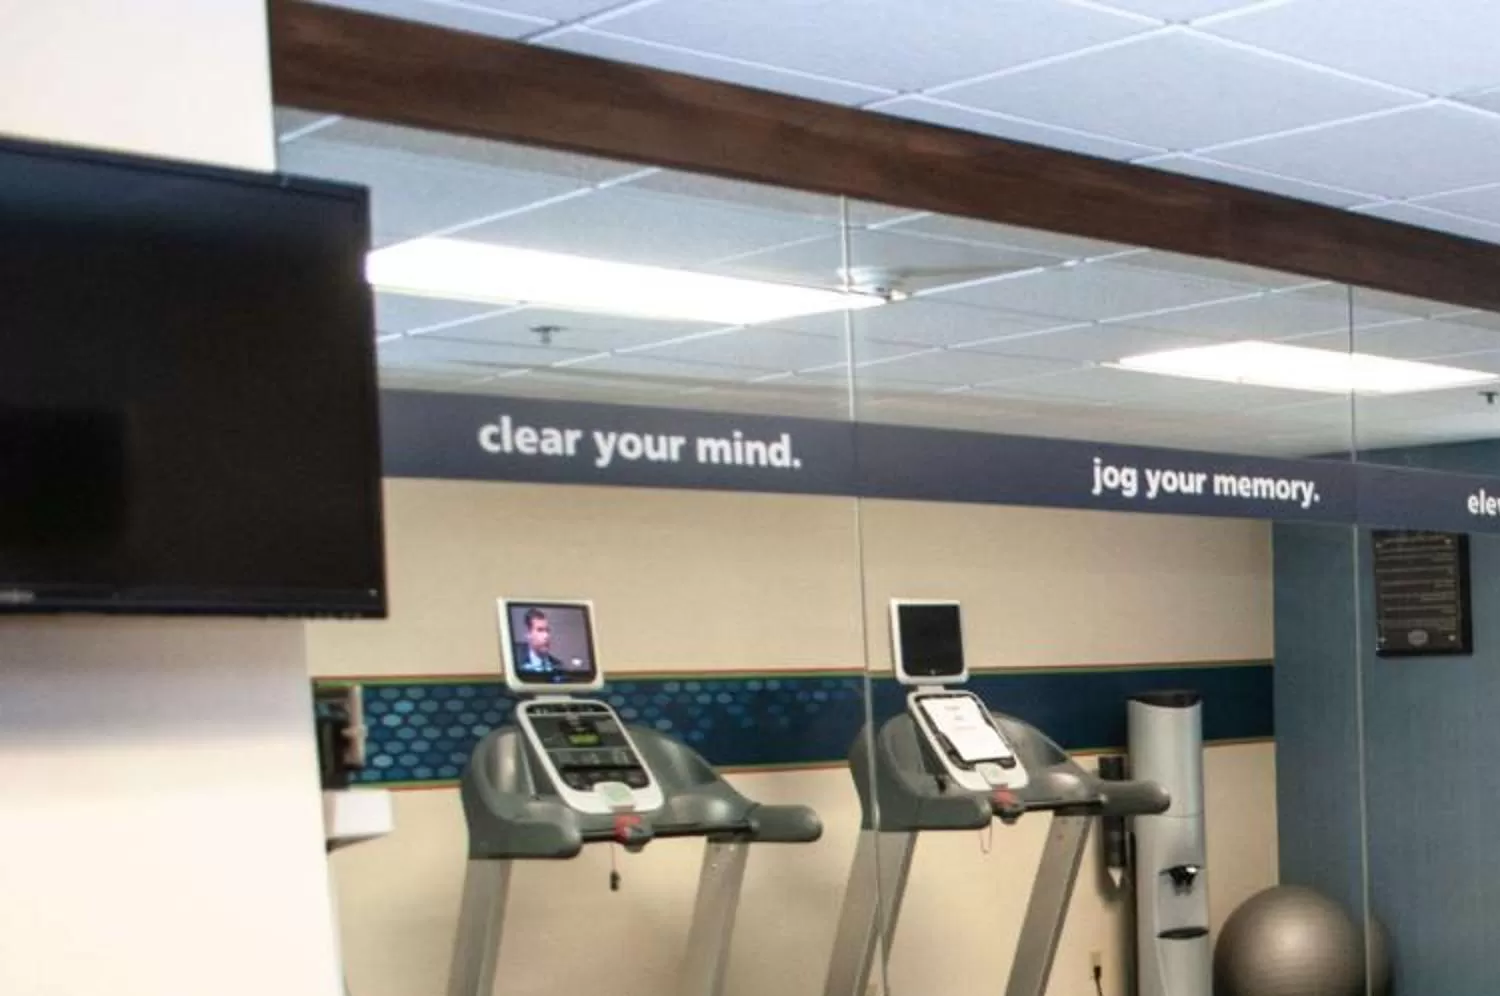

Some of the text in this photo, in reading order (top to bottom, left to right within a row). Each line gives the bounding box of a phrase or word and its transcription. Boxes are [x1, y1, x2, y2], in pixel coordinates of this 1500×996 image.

[478, 415, 802, 468] clear your mind.
[1092, 457, 1320, 509] jog your memory.
